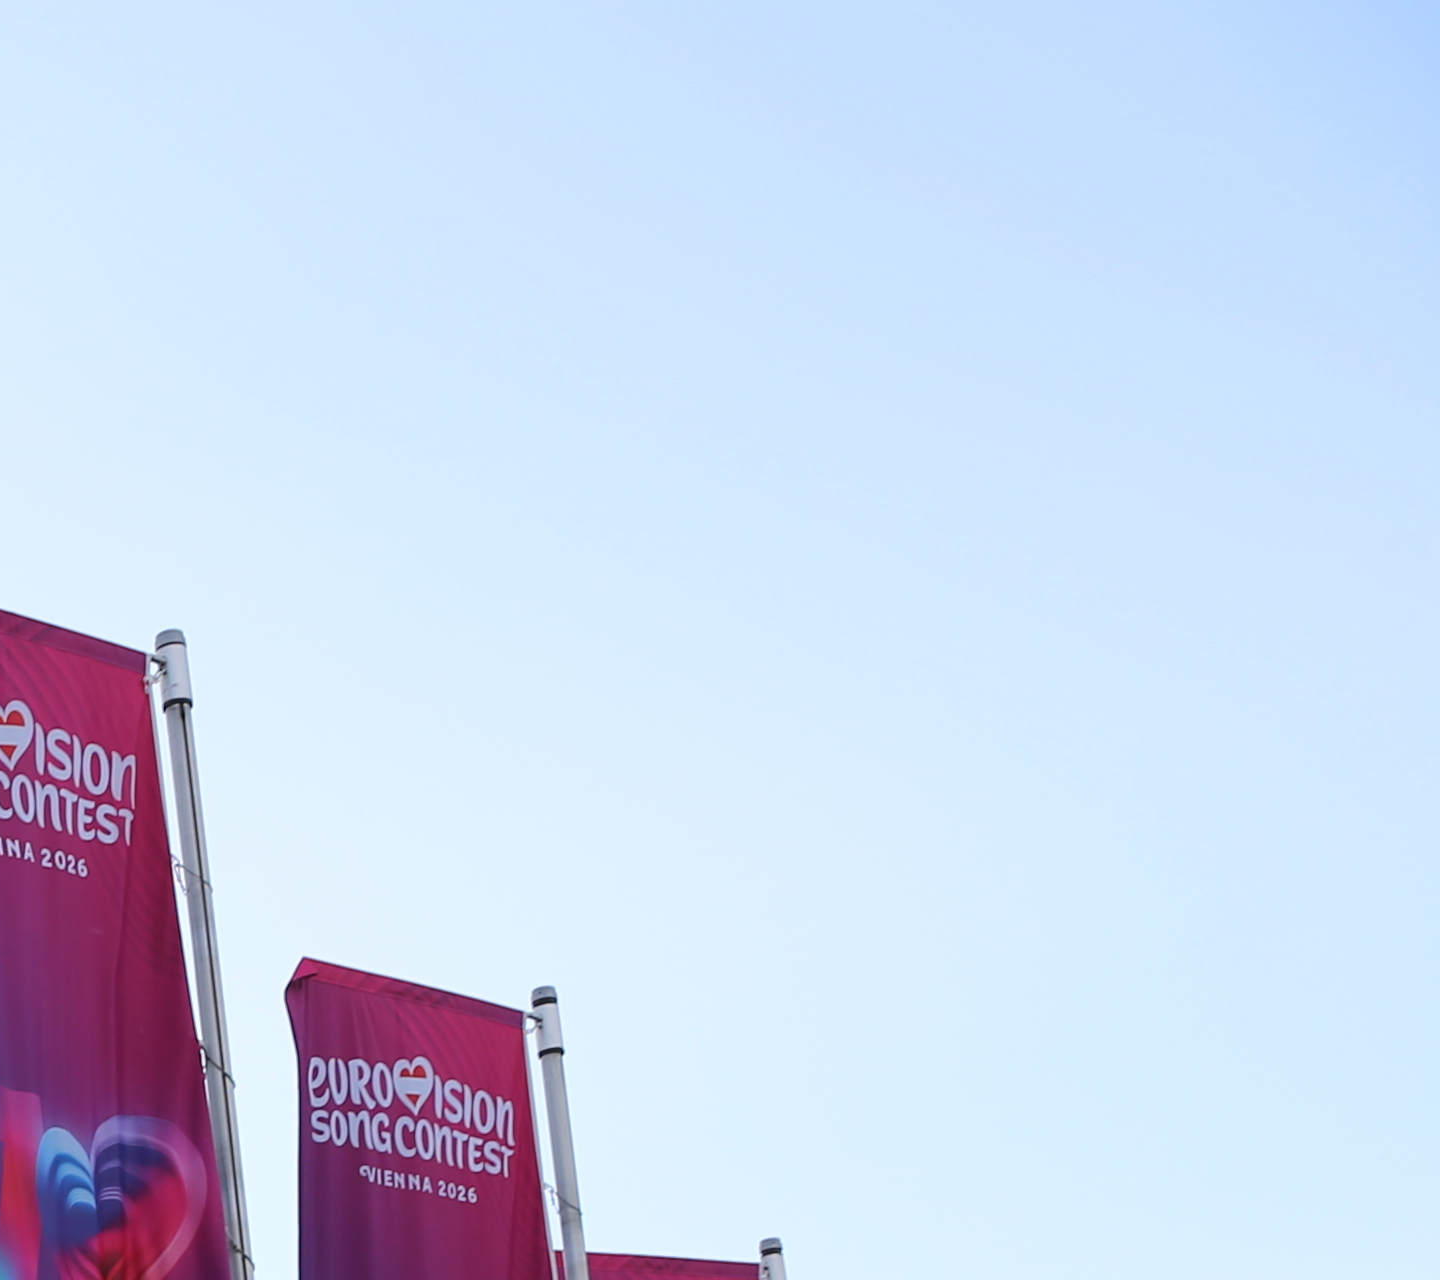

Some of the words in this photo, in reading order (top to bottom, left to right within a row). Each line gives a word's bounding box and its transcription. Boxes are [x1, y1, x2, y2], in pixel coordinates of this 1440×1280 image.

[40, 846, 90, 879] 2026
[310, 1109, 393, 1156] SONG
[393, 1116, 515, 1180] CONTEST
[358, 1163, 433, 1195] VIENNA
[436, 1176, 479, 1206] 2026
